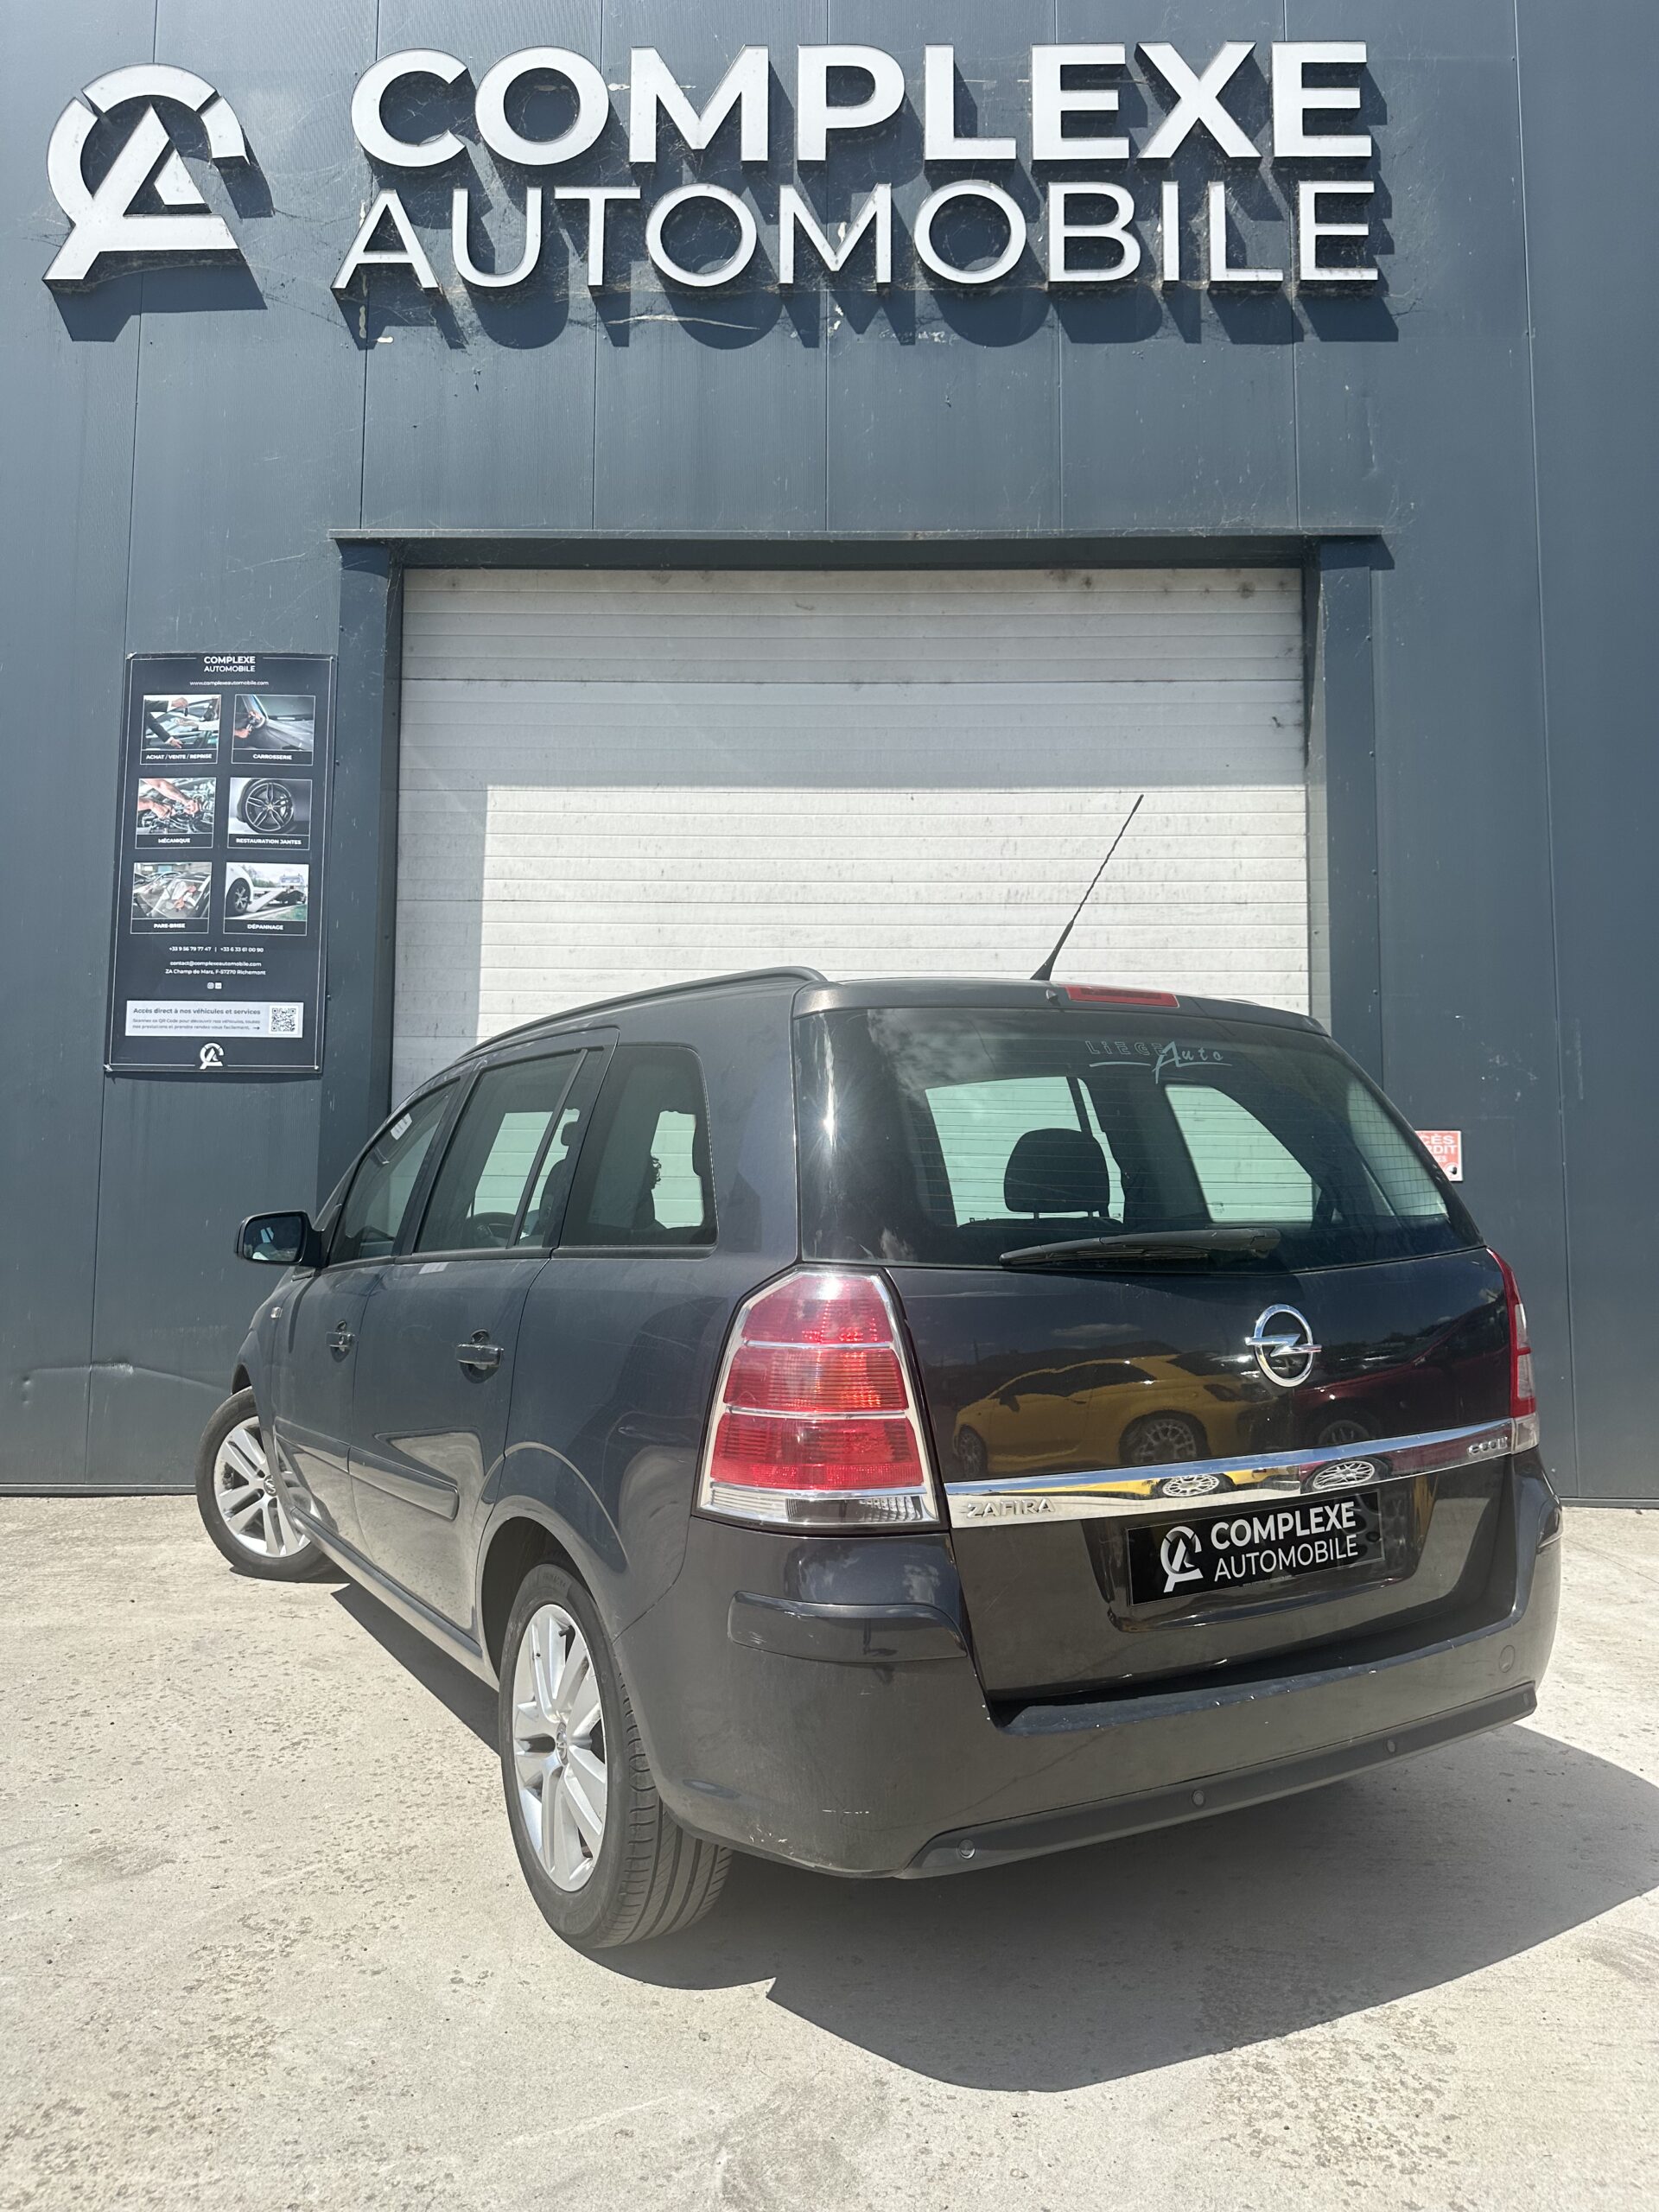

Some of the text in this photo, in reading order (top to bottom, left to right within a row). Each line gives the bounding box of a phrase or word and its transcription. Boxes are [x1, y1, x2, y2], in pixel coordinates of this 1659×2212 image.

[351, 41, 1372, 167] COMPLEXE
[330, 180, 1378, 289] AUTOMOBILE
[204, 656, 256, 664] COMPLEXE
[158, 836, 191, 844] MÉCANIQUE
[247, 922, 283, 931] DÉPANNAGE
[1152, 1041, 1224, 1084] Auto
[967, 1497, 1056, 1518] ZAFIRA
[1211, 1501, 1357, 1550] COMPLEXE
[1214, 1534, 1358, 1582] AUTOMOBILE
